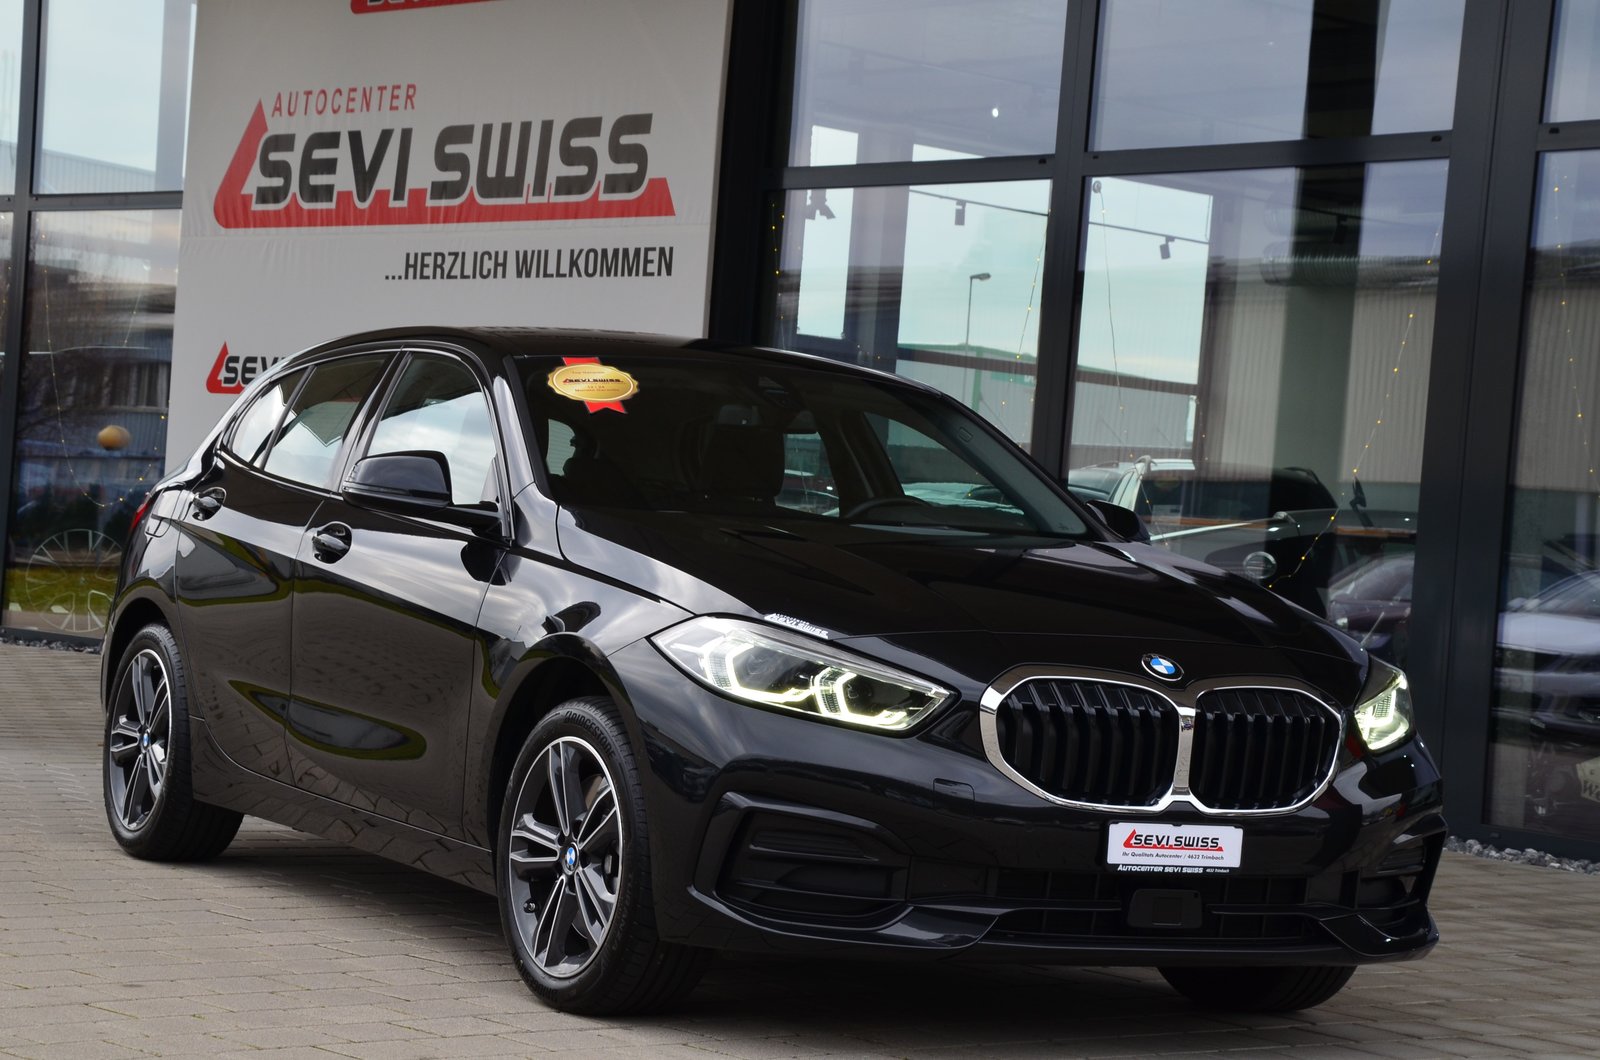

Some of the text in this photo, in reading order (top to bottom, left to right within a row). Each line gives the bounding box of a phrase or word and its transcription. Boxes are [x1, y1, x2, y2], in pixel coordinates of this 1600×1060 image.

[271, 83, 417, 118] AUTOCENTER
[254, 113, 653, 204] SEVI SWISS
[385, 246, 674, 281] ...HERZLICH WILLKOMMEN
[223, 355, 285, 384] SEV
[565, 710, 616, 759] BRIDGESTONE
[1133, 834, 1220, 848] SEVI SWISS
